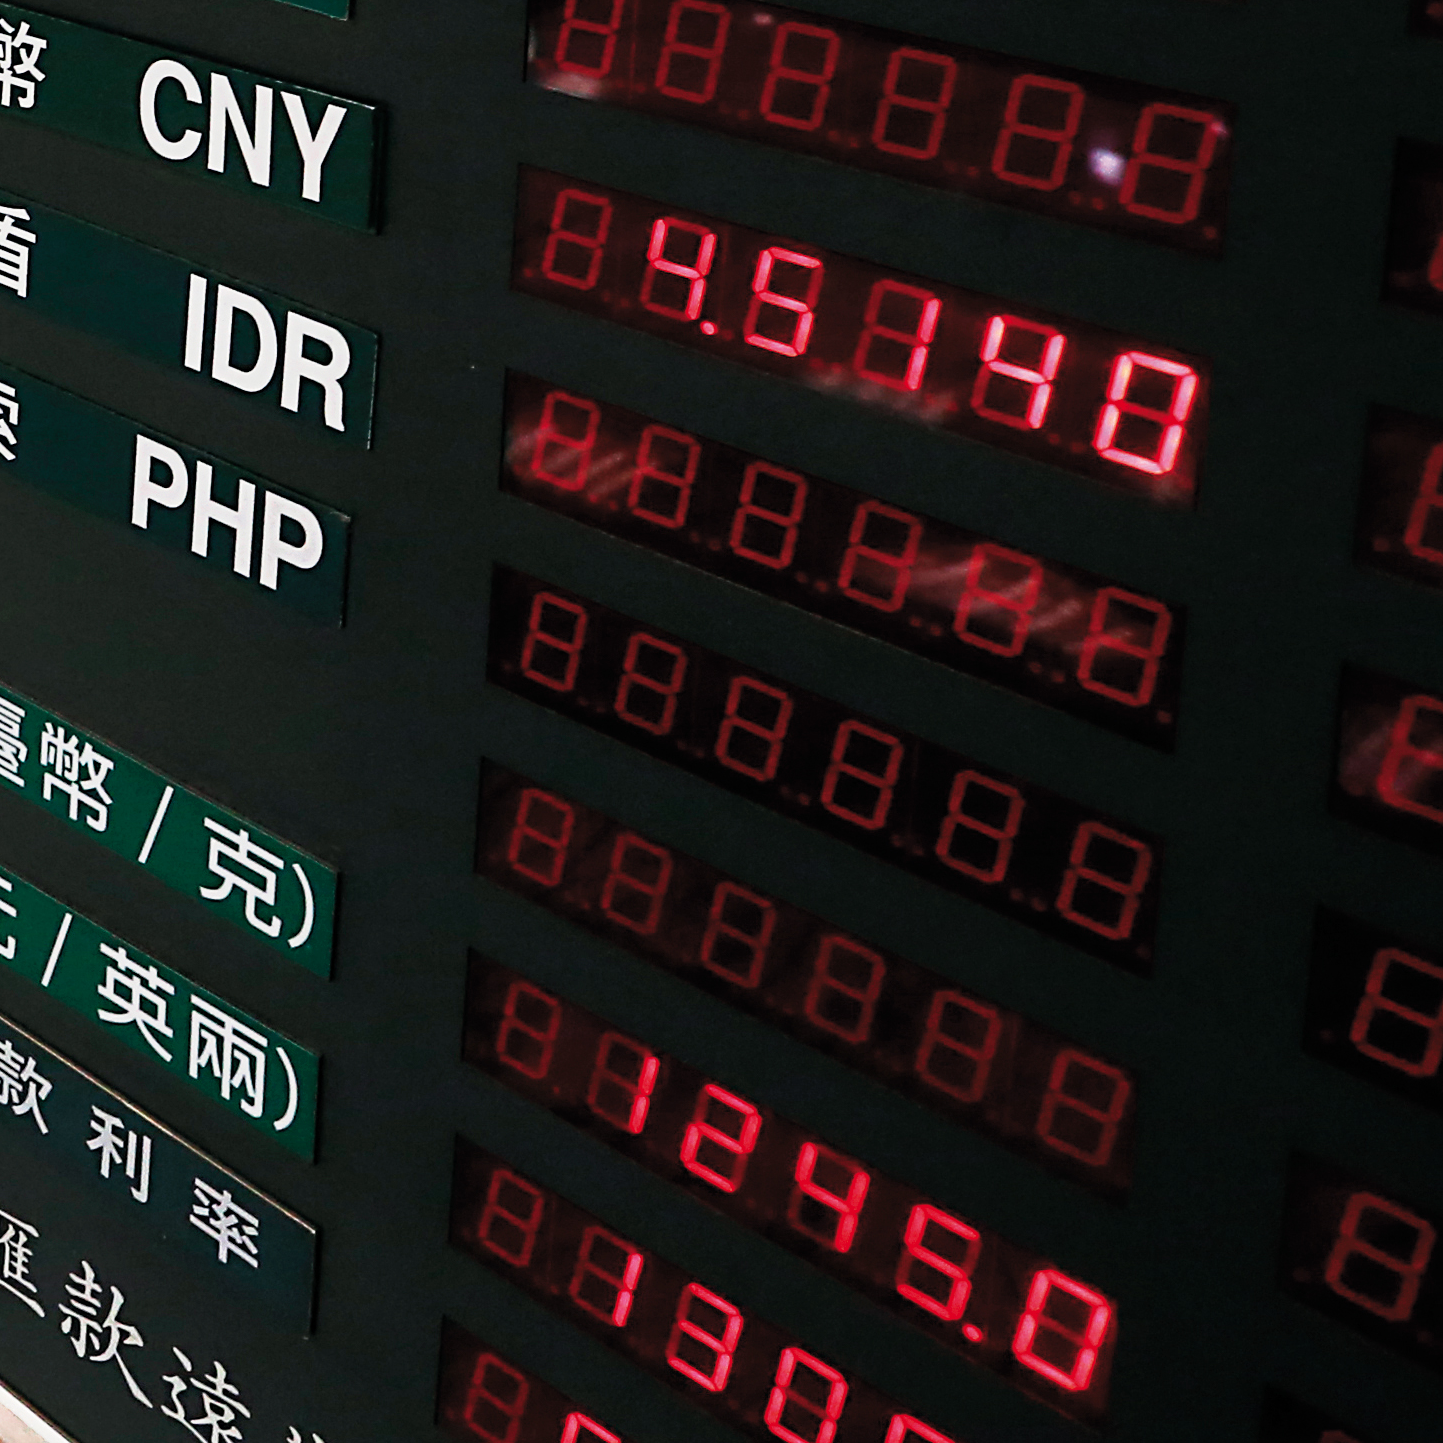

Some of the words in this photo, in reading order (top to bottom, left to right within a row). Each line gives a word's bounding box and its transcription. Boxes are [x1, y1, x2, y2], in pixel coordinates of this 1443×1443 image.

[140, 60, 347, 202] CNY
[185, 274, 350, 431] IDR
[132, 433, 323, 591] PHP
